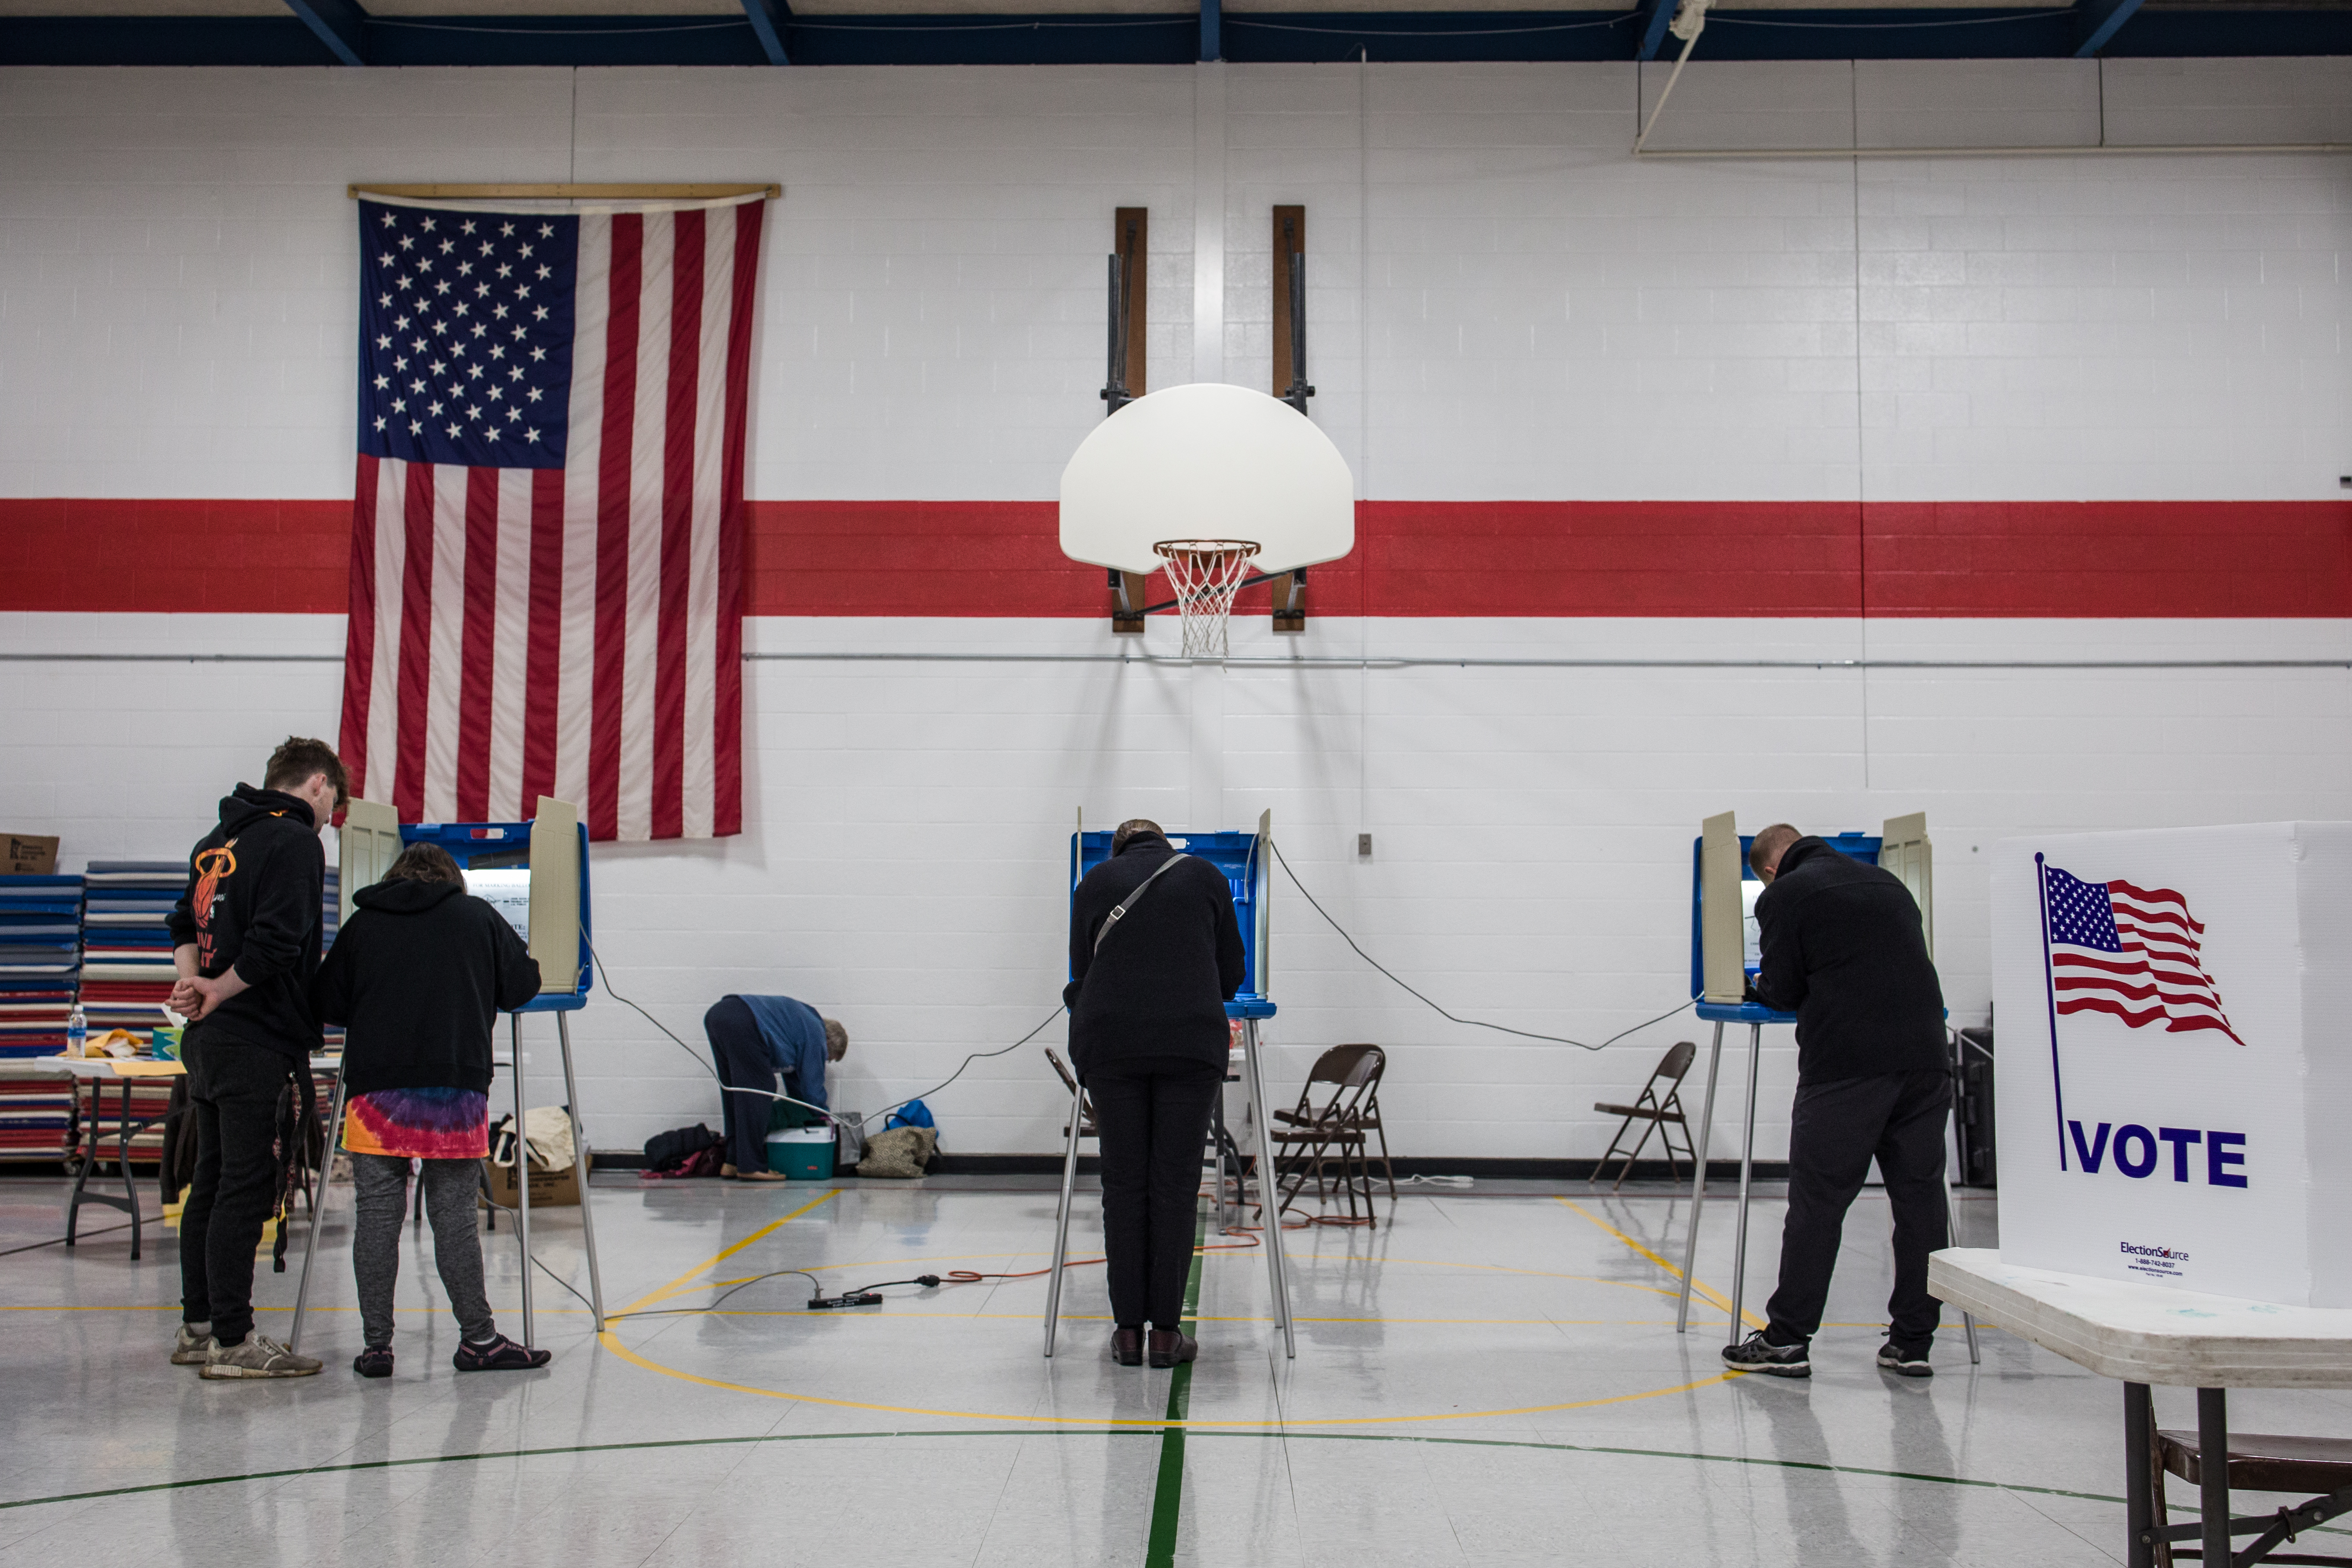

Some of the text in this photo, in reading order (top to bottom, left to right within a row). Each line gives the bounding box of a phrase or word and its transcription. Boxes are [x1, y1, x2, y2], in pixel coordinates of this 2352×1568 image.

[2067, 1120, 2248, 1188] VOTE
[2135, 1258, 2175, 1268] 1-888-742-8037
[2128, 1265, 2182, 1276] www.electionsource.com
